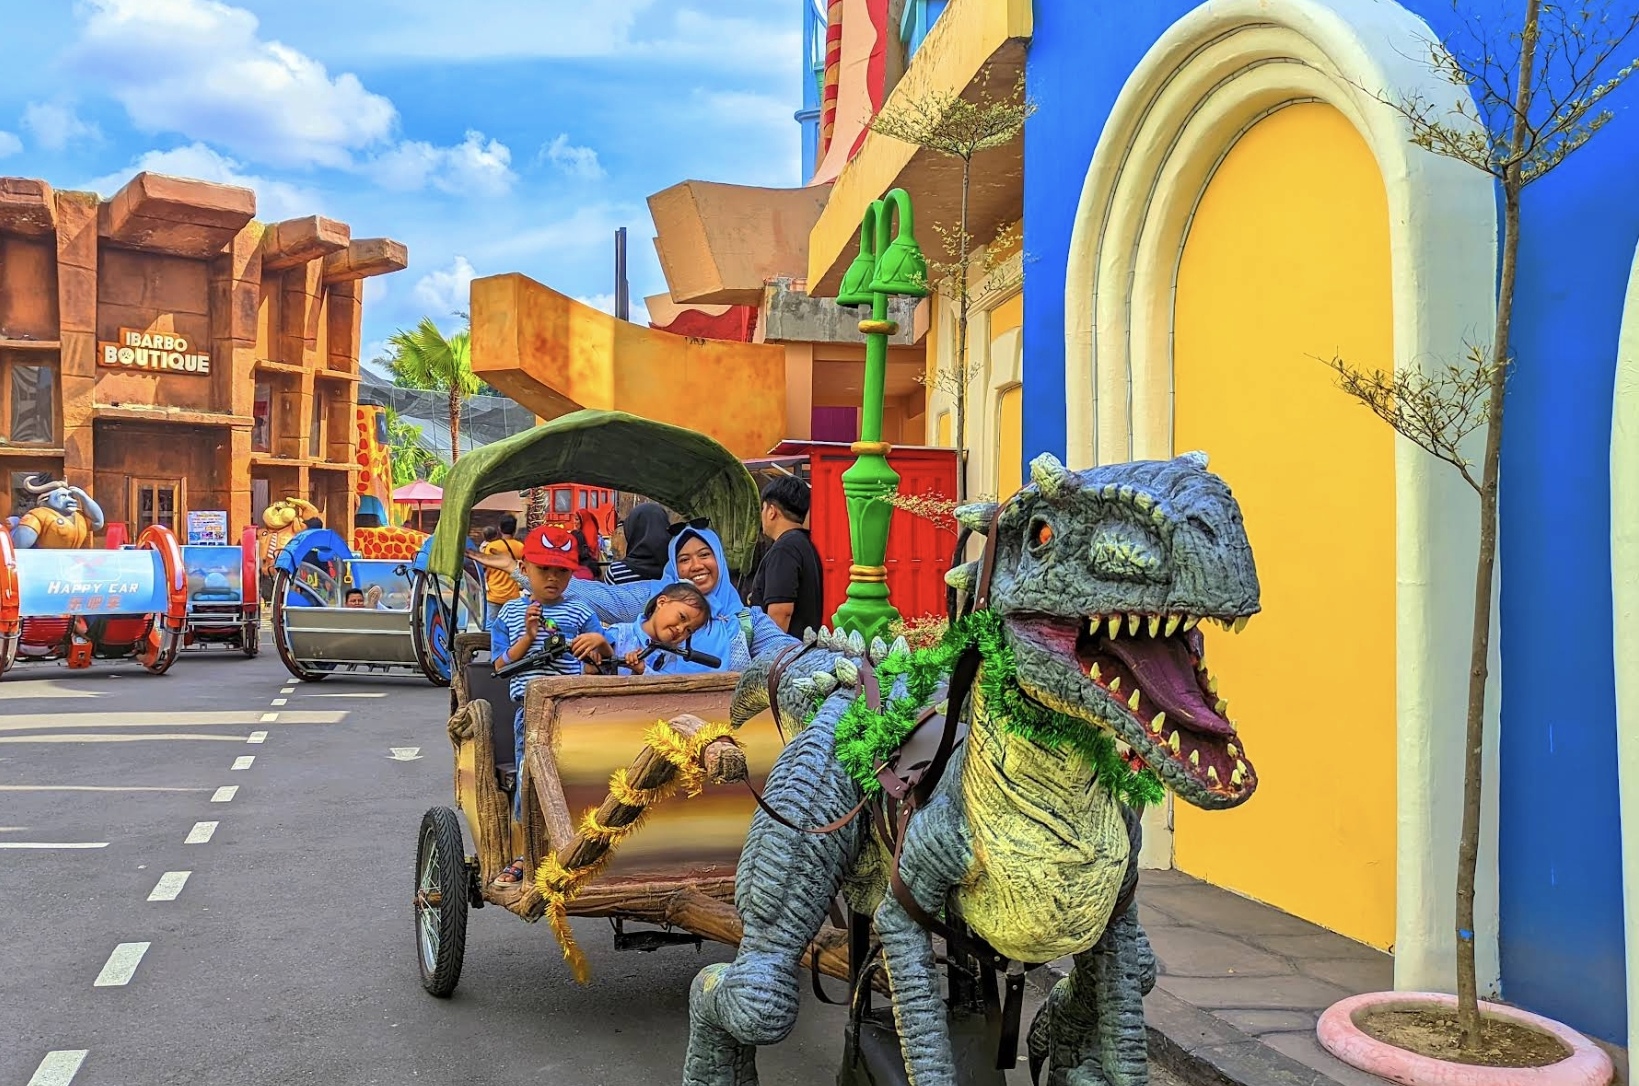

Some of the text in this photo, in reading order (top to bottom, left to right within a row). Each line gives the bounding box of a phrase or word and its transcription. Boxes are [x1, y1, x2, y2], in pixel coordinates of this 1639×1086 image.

[125, 331, 188, 352] IBARBO
[104, 345, 210, 373] BOUTIQUE
[47, 581, 102, 594] HAPPY
